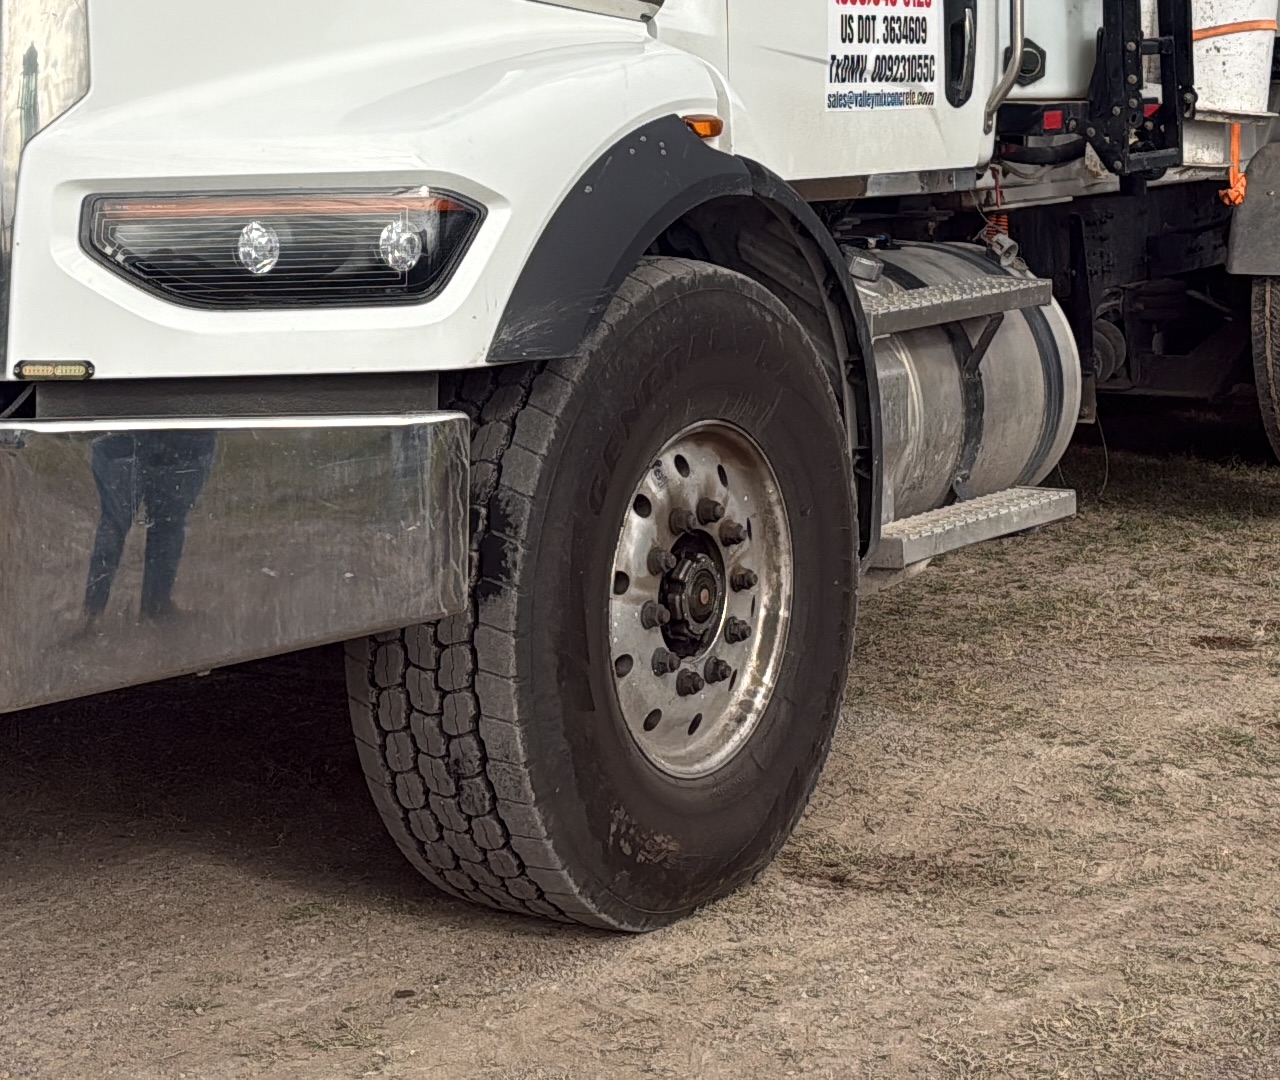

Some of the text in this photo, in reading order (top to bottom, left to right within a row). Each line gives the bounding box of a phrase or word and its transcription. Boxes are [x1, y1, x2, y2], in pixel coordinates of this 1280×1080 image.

[840, 14, 927, 45] US DOT. 3634609
[829, 54, 935, 84] TxDMV. 009231055C
[827, 89, 935, 109] sales@valleymixconcrete.com
